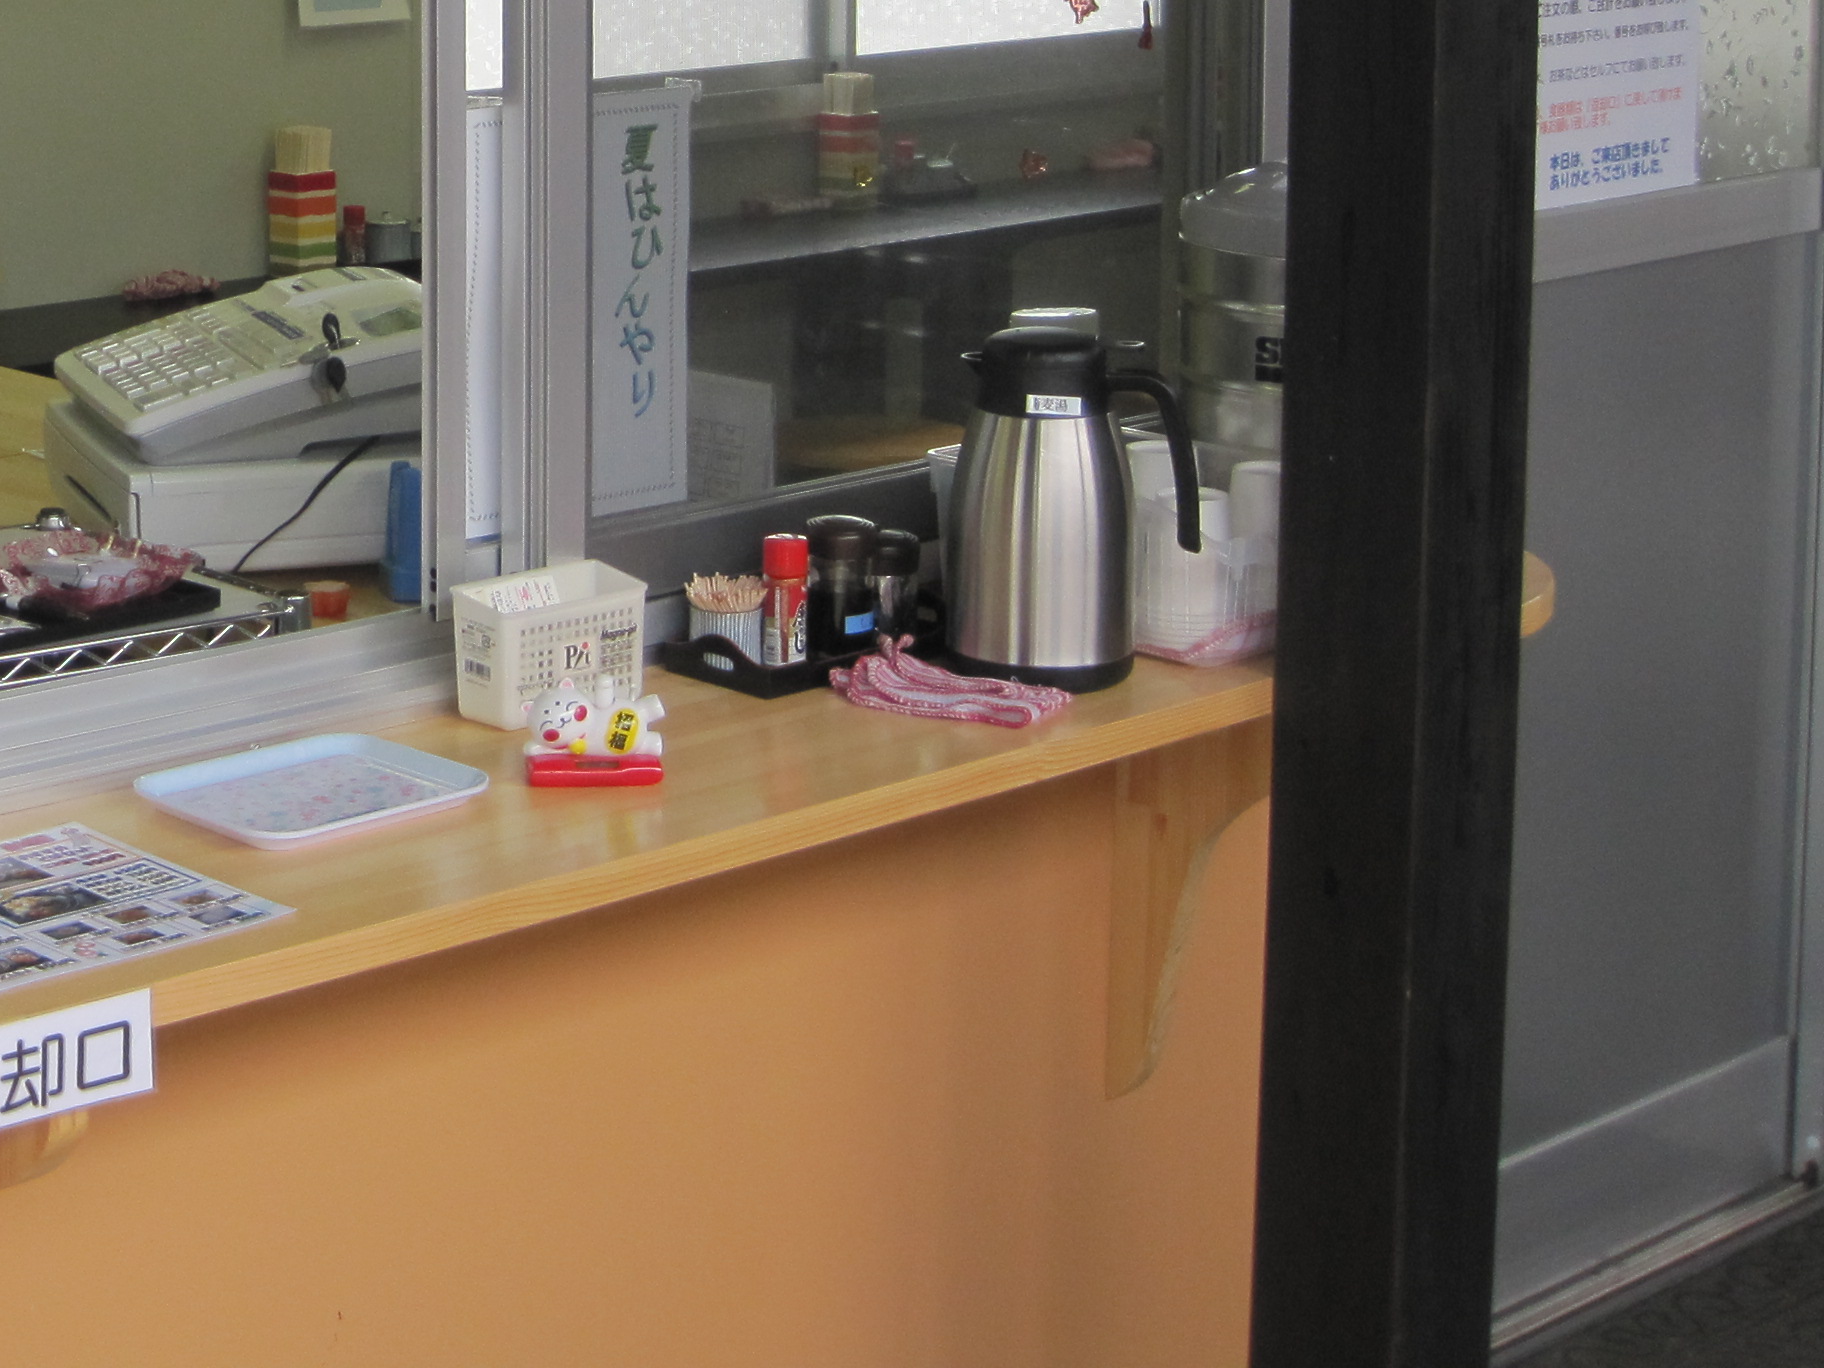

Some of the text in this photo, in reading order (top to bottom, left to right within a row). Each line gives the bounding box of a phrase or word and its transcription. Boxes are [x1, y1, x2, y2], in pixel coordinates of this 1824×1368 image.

[612, 123, 664, 418] 夏はひんやり
